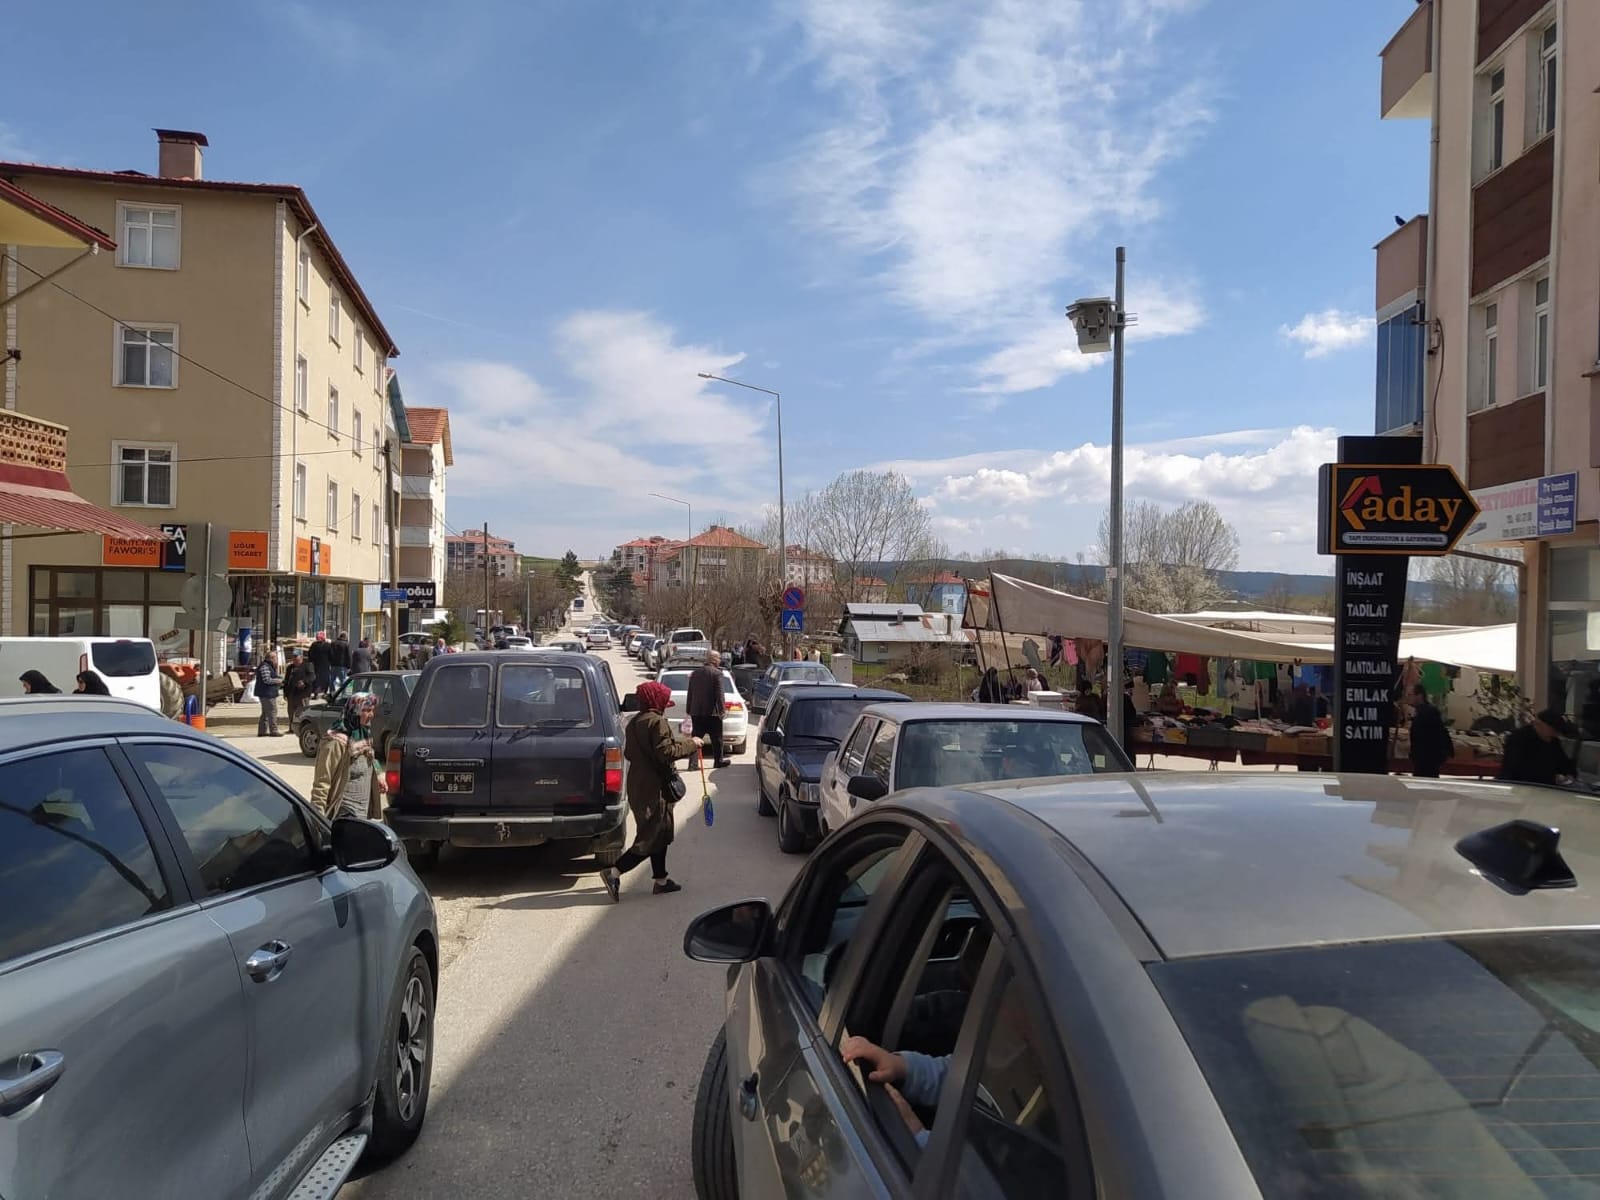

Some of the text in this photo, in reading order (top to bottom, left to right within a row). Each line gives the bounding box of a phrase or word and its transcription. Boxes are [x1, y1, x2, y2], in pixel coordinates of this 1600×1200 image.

[1346, 568, 1384, 589] İNŞAAT
[1346, 599, 1389, 617] TADİLAT
[1345, 660, 1392, 675] MANTOLAMA
[1346, 688, 1389, 702] EMLAK
[1346, 707, 1378, 721] ALIM
[1345, 725, 1383, 740] SATIM
